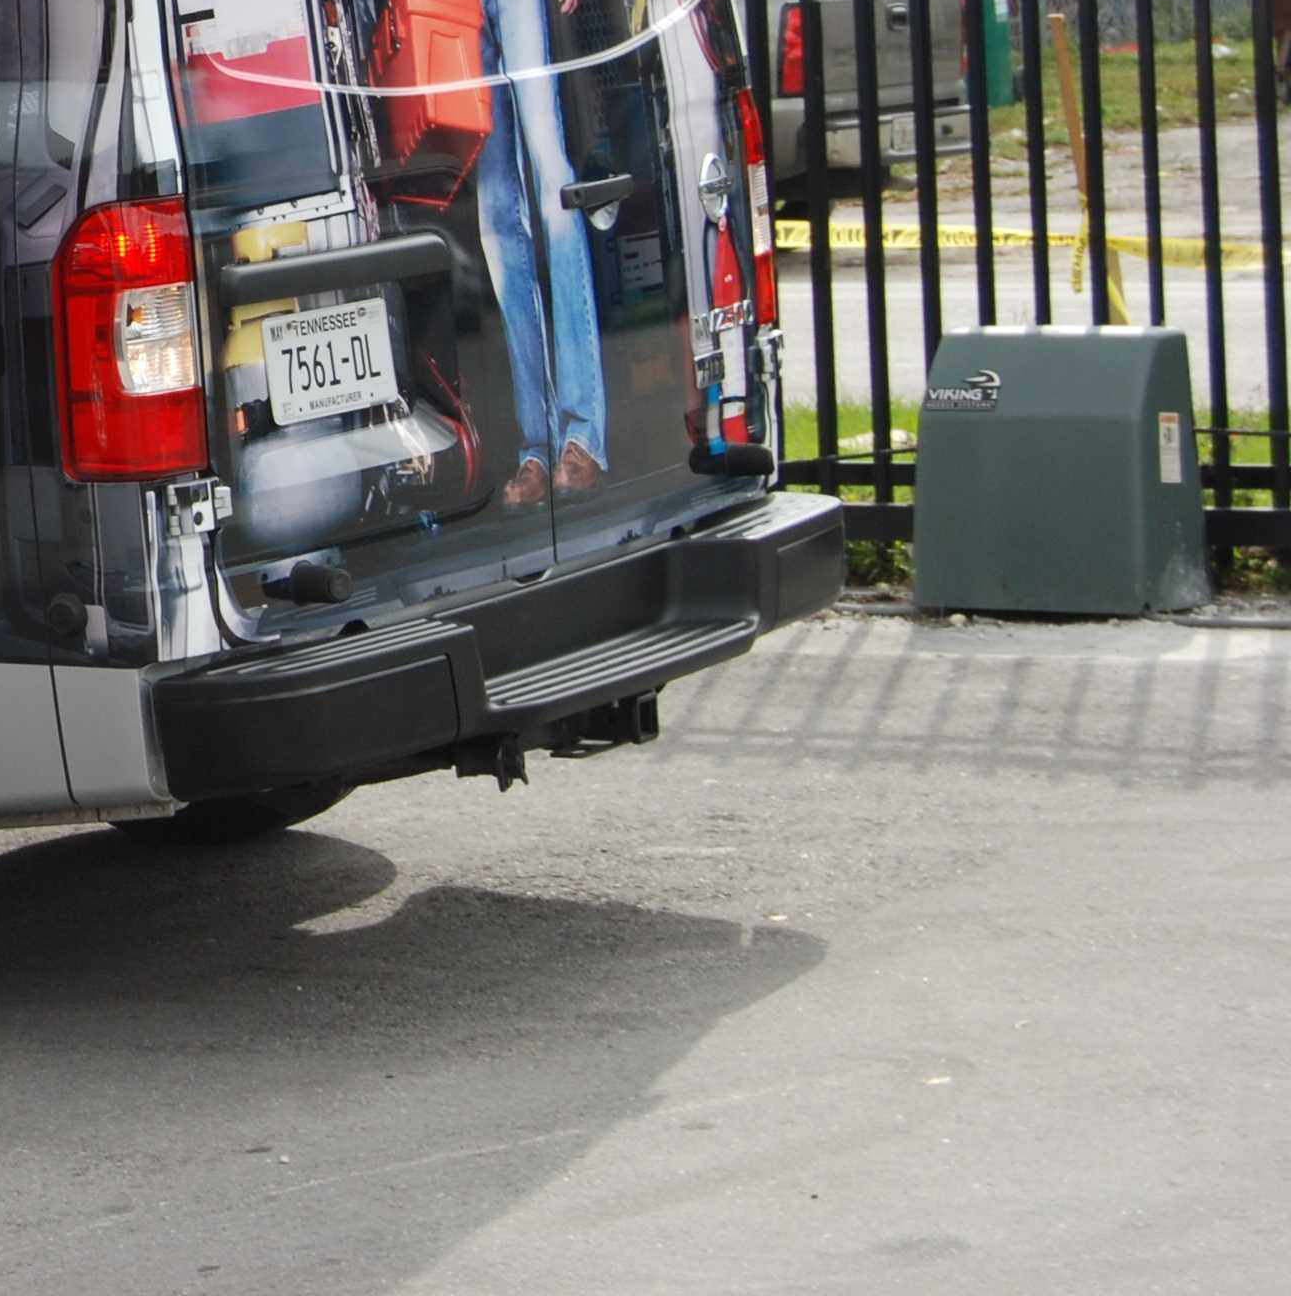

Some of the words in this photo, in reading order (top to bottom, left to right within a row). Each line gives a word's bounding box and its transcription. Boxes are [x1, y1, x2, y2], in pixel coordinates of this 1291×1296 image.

[292, 311, 357, 337] TENNESSEE
[281, 334, 381, 394] 7561-DL
[929, 388, 983, 401] VIKING
